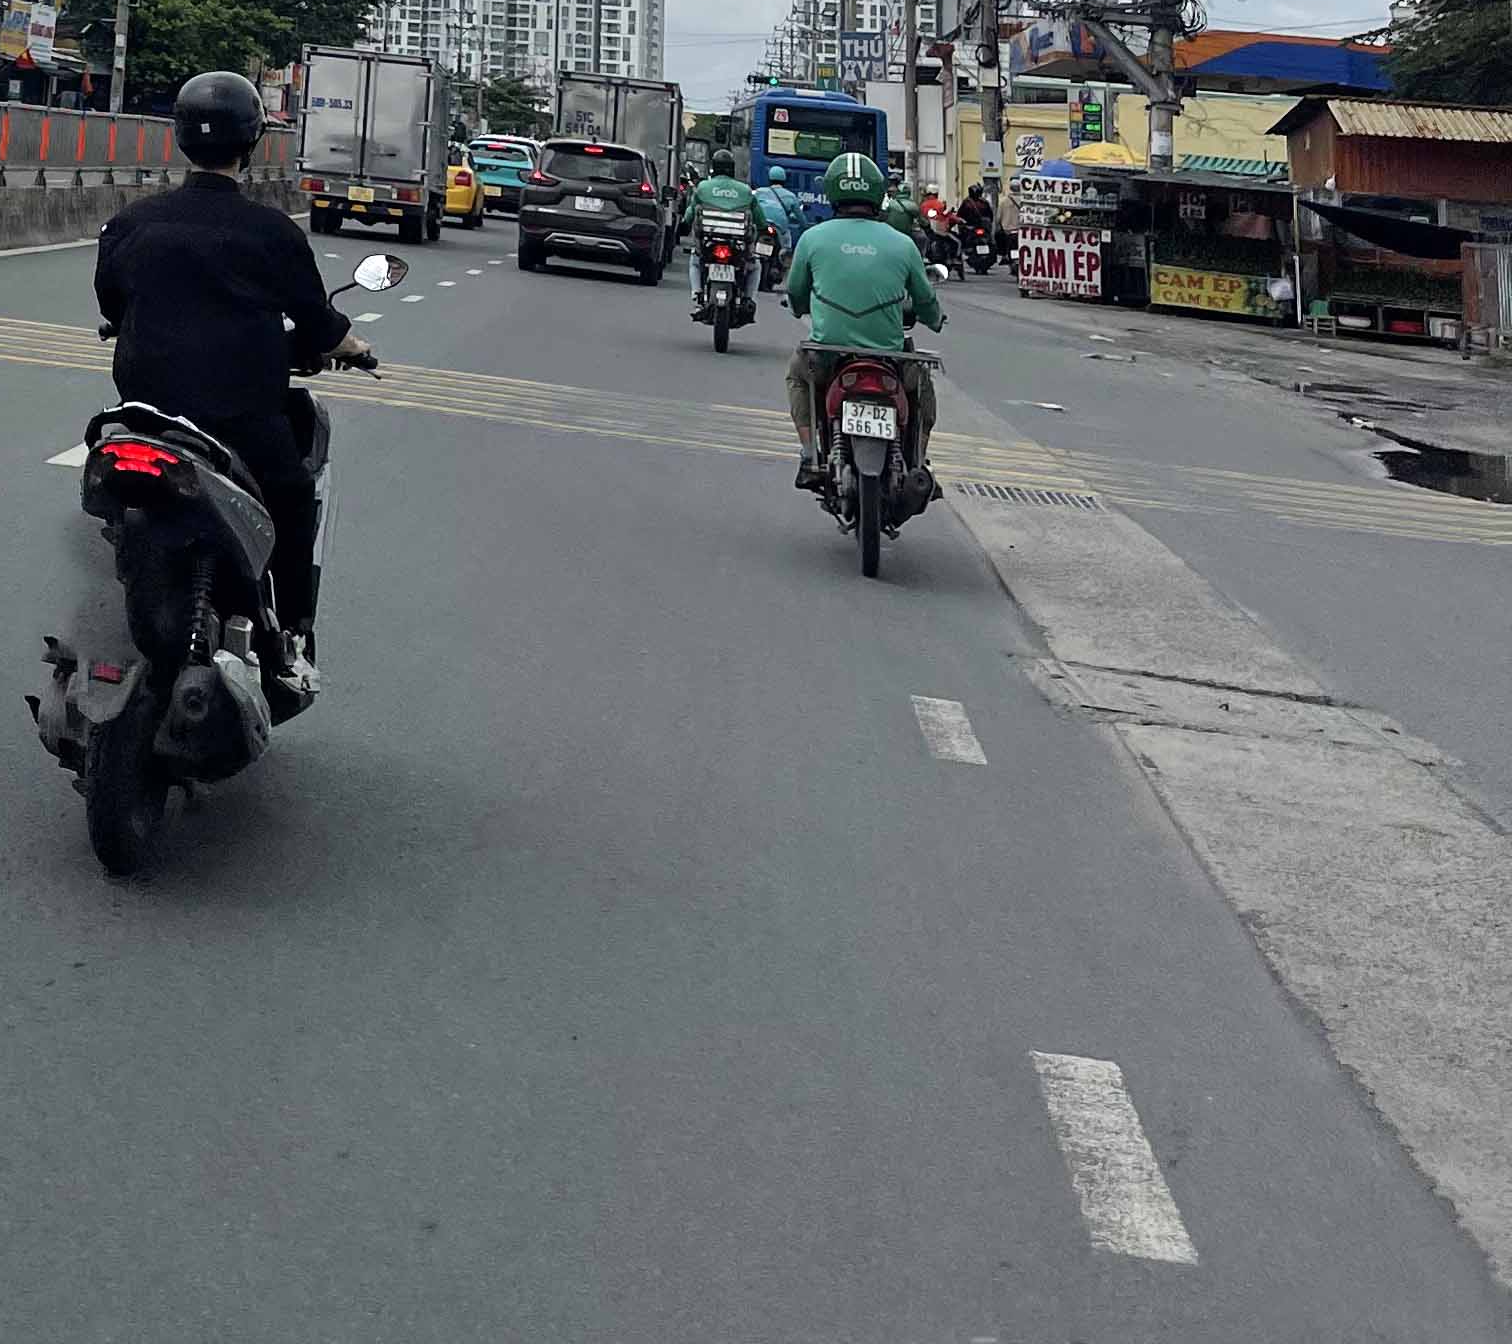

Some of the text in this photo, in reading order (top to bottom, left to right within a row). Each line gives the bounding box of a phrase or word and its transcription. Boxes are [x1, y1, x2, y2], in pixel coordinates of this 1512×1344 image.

[842, 34, 884, 59] THÚ
[838, 177, 870, 191] Grab
[1021, 177, 1055, 193] CAM
[712, 186, 738, 199] Grab
[840, 242, 877, 256] Grab
[1019, 244, 1101, 282] CAM ÉP
[1154, 270, 1205, 290] CAM
[1162, 290, 1201, 305] CAM
